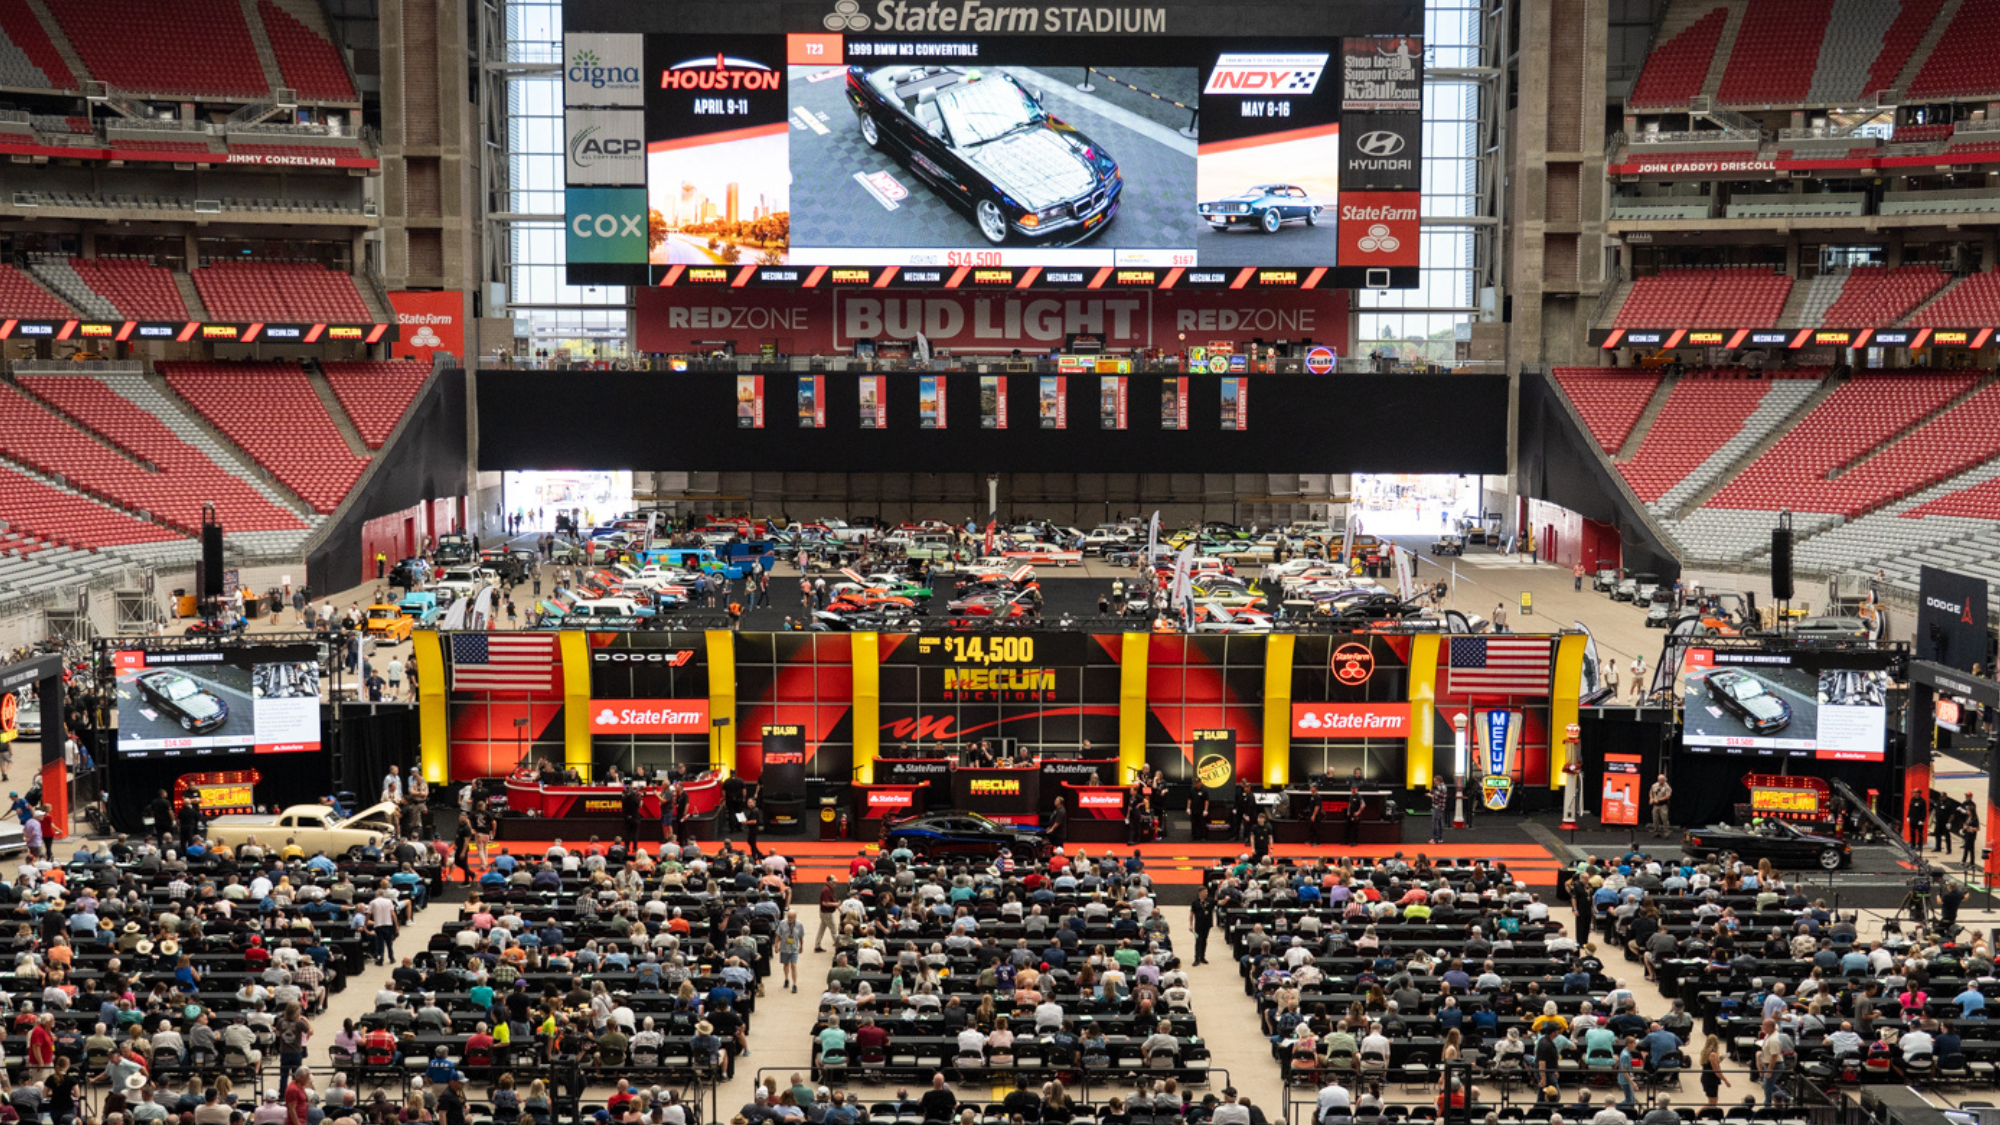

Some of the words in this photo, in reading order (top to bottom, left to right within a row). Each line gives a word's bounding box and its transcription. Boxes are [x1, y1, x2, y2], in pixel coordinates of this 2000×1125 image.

[1044, 8, 1166, 33] STADIUM
[806, 43, 823, 55] T23
[849, 43, 872, 56] 1999
[874, 44, 898, 56] BMW
[900, 44, 914, 56] M3
[916, 44, 978, 57] CONVERTIBLE
[1345, 55, 1372, 69] Shop
[1373, 55, 1400, 68] Local
[569, 61, 639, 88] cigna
[661, 70, 780, 90] HOUSTON
[1211, 71, 1291, 89] INDY
[1345, 68, 1386, 81] Support
[1388, 68, 1415, 80] Local
[694, 99, 724, 115] APRIL
[727, 99, 748, 115] 9-11
[1241, 101, 1265, 117] MAY
[1267, 101, 1290, 117] 8-16
[581, 138, 642, 155] ACP
[226, 154, 262, 164] JIMMY
[265, 155, 336, 167] CONZELMAN
[1348, 159, 1412, 170] HYUNDAI
[1638, 163, 1668, 173] JOHN
[1670, 162, 1719, 173] (PADDY)
[1720, 161, 1776, 172] DRISCOLL
[572, 214, 642, 238] COX
[1172, 255, 1193, 265] $167
[689, 269, 727, 278] MECUM
[761, 271, 797, 281] MECUM.COM
[832, 270, 869, 279] MECUM
[904, 272, 940, 281] MECUM.COM
[975, 271, 1012, 279] MECUM
[1046, 272, 1083, 282] MECUM.COM
[1117, 271, 1154, 280] MECUM
[1189, 273, 1225, 282] MECUM.COM
[1260, 272, 1297, 280] MECUM
[669, 306, 809, 330] REDZONE
[845, 298, 965, 339] BUD
[974, 299, 1140, 340] LIGHT
[1177, 308, 1316, 332] REDZONE
[1308, 357, 1332, 366] Gulf
[1927, 596, 1961, 614] DODGE
[594, 653, 678, 661] DODGE
[944, 635, 1034, 667] $14,500
[944, 668, 1056, 690] MECUM
[943, 691, 1056, 700] AUCTIONS
[1492, 712, 1505, 773] MECUM
[765, 752, 803, 764] ESPN
[1201, 765, 1230, 783] SOLD
[970, 780, 1019, 790] MECUM
[200, 786, 251, 806] ECUM
[1753, 789, 1816, 811] MECUM
[201, 807, 252, 815] CTIONS
[586, 800, 622, 809] MECUM
[1752, 811, 1816, 820] AUCTIONS
